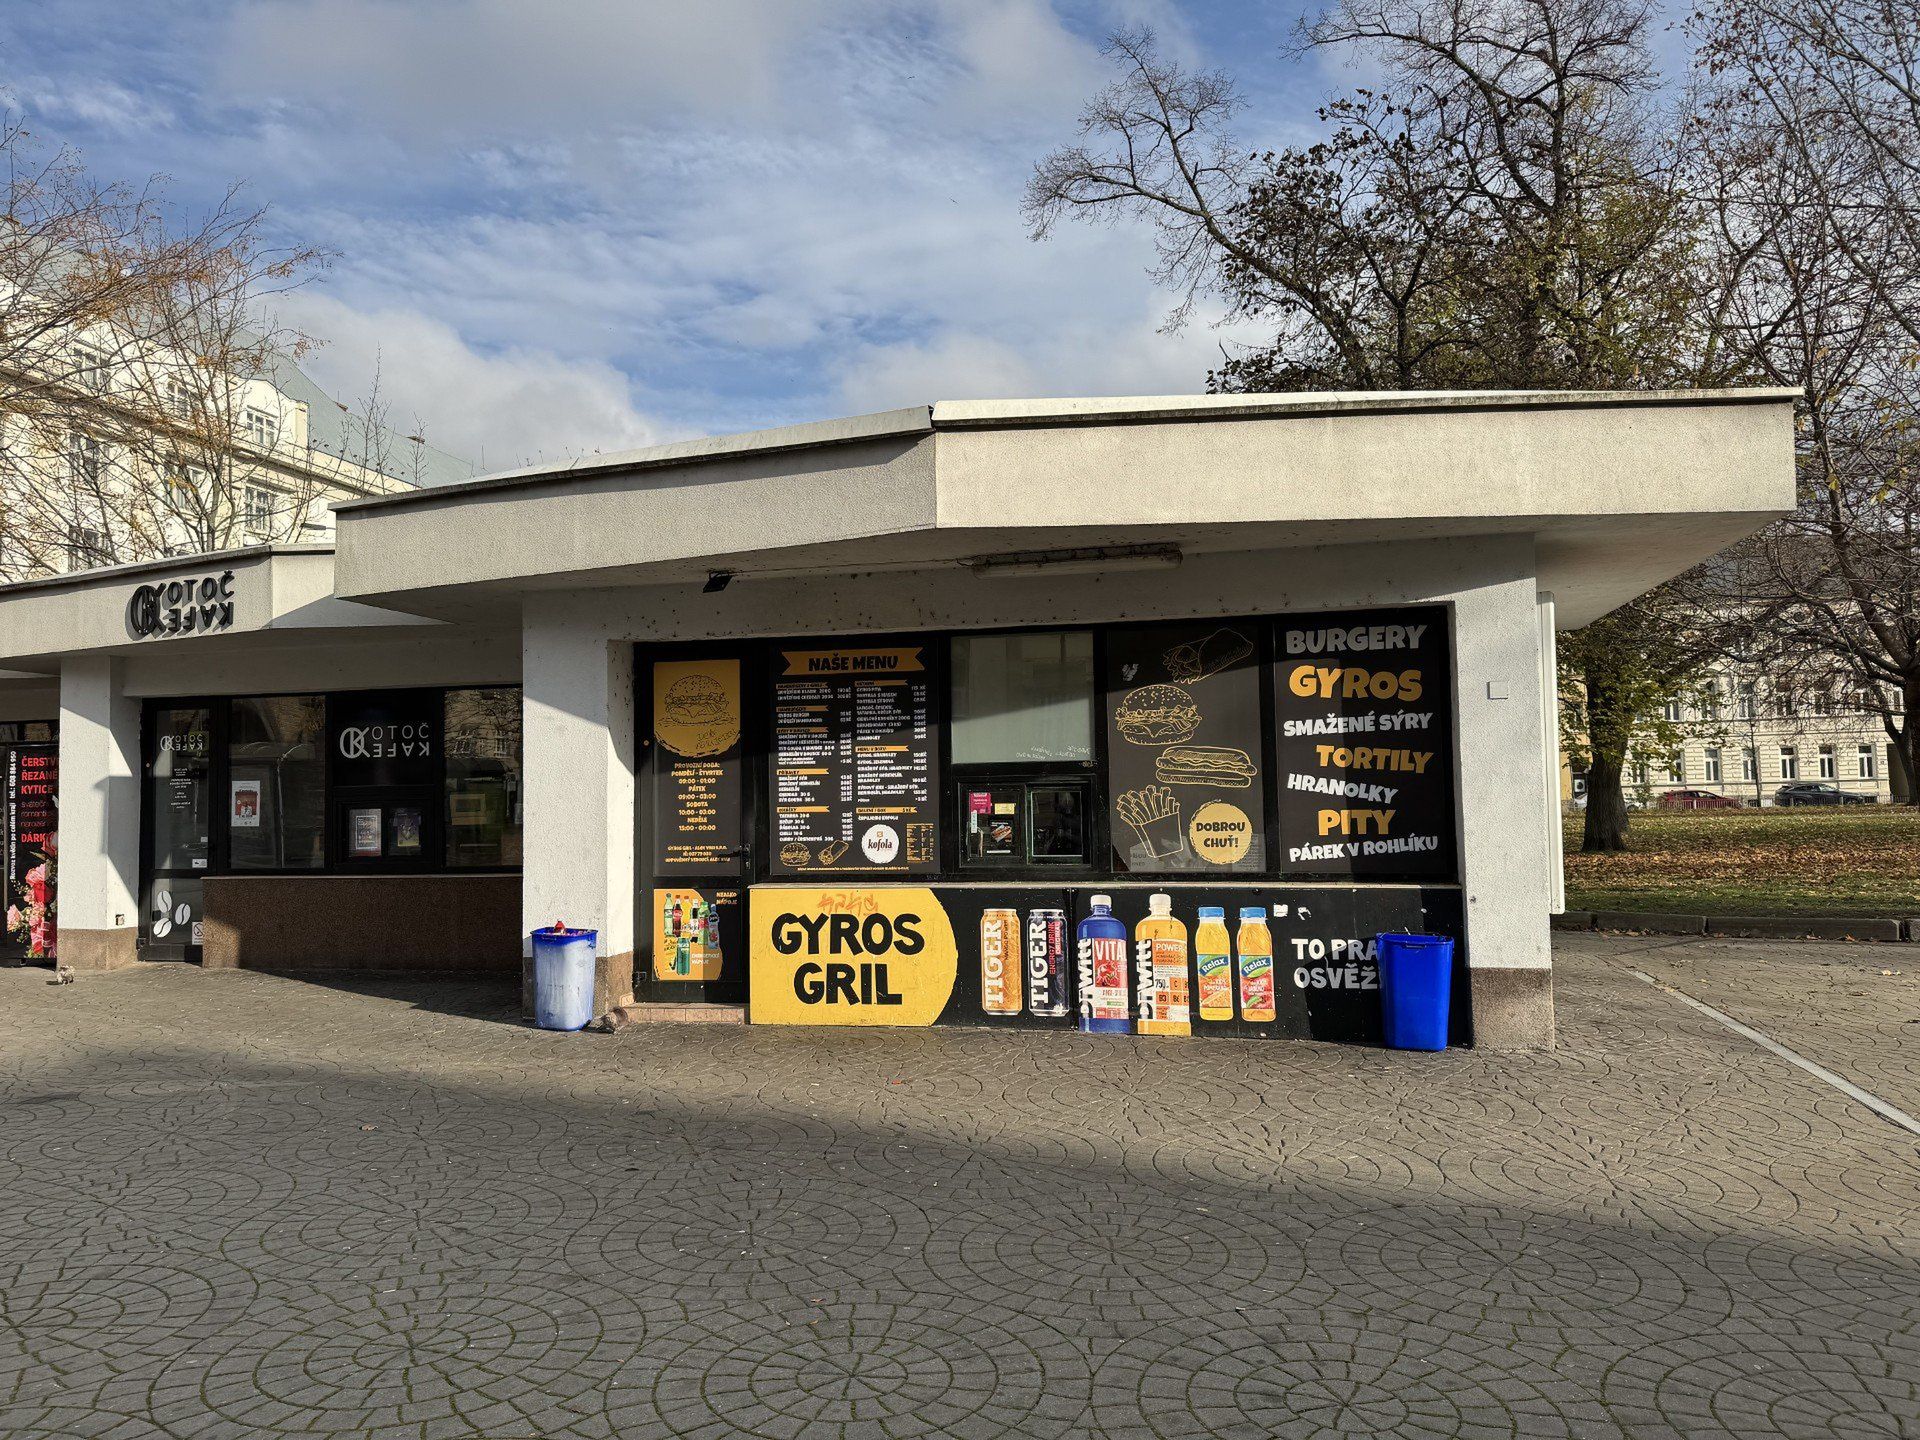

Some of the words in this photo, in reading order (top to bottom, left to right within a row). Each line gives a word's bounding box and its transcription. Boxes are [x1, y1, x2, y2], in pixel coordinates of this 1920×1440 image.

[168, 570, 234, 603] OTOČ
[168, 602, 234, 632] KAFE
[1286, 624, 1428, 654] BURGERY
[808, 652, 850, 672] NAŠE
[852, 656, 898, 670] MENU
[1288, 665, 1422, 701] GYROS
[372, 722, 428, 740] OTOČ
[1284, 710, 1376, 736] SMAŽENÉ
[1379, 708, 1434, 730] SÝRY
[373, 742, 430, 758] KAFE
[1316, 744, 1434, 774] TORTILY
[22, 785, 53, 794] KYTICE
[1287, 773, 1398, 804] HRANOLKY
[1196, 822, 1245, 832] DOBROU
[1318, 809, 1396, 835] PITY
[868, 839, 892, 851] kofola
[1204, 835, 1239, 848] CHUŤ!
[1289, 842, 1345, 862] PÁREK
[1347, 843, 1360, 856] V
[1363, 833, 1438, 855] ROHLÍKU
[772, 912, 925, 956] GYROS
[1291, 939, 1325, 960] TO
[984, 920, 1004, 1008] TIGER
[1029, 921, 1048, 1007] TIGER
[1201, 958, 1226, 973] Relax
[1243, 958, 1268, 974] Relax
[794, 962, 902, 1005] GRIL
